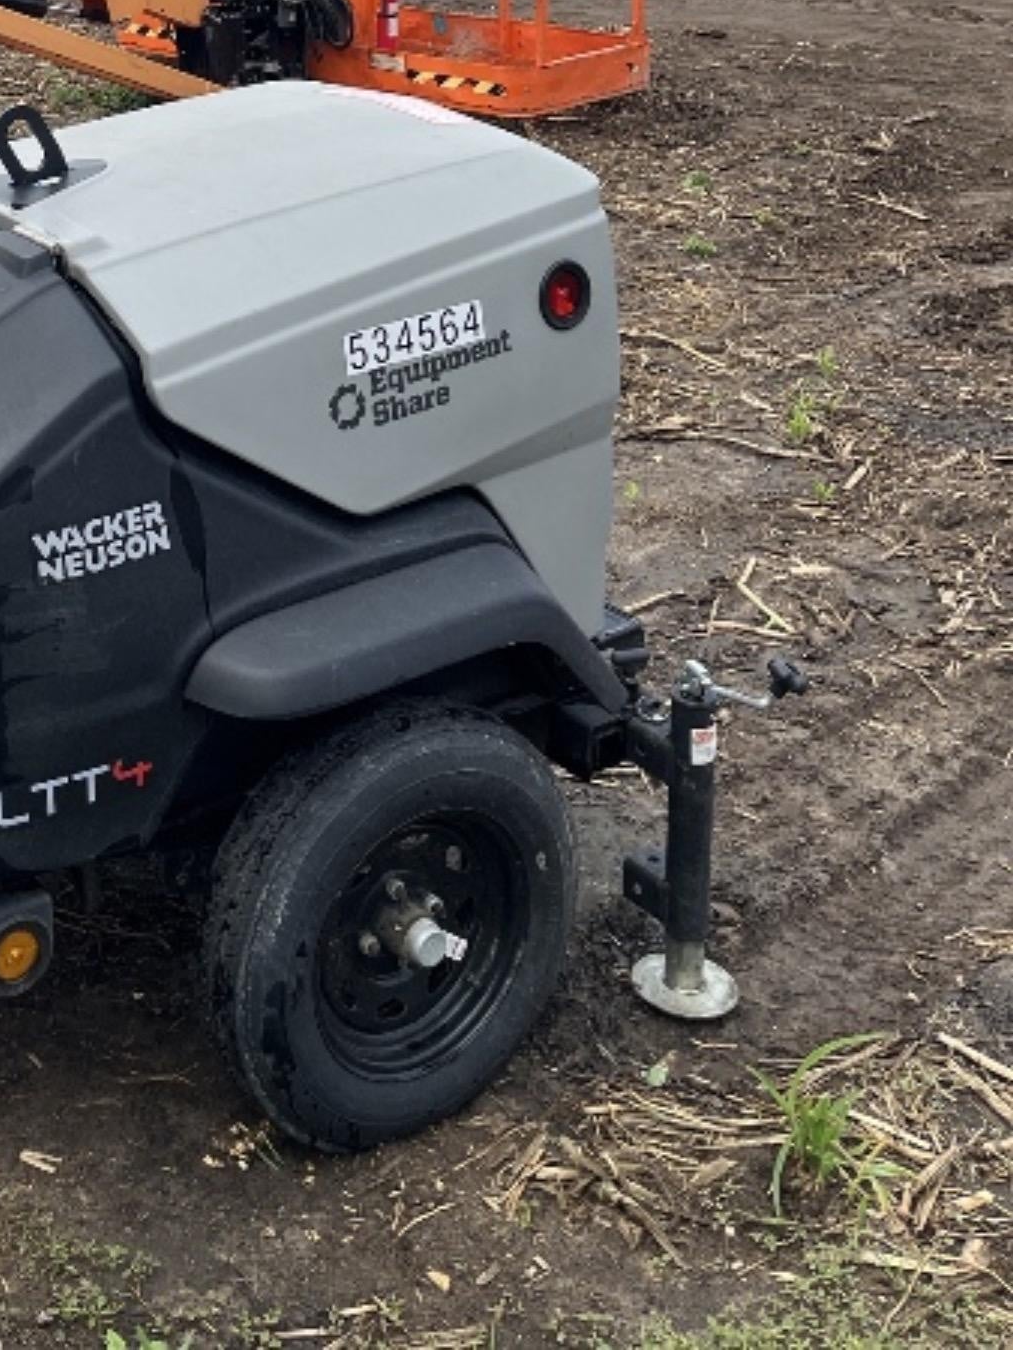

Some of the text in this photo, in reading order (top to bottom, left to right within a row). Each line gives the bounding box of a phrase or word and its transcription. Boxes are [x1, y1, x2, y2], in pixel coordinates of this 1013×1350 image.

[349, 305, 480, 369] 534564
[369, 329, 512, 396] Equipment
[371, 386, 450, 426] Share
[31, 501, 165, 558] WACKER
[38, 524, 171, 582] NEUSON
